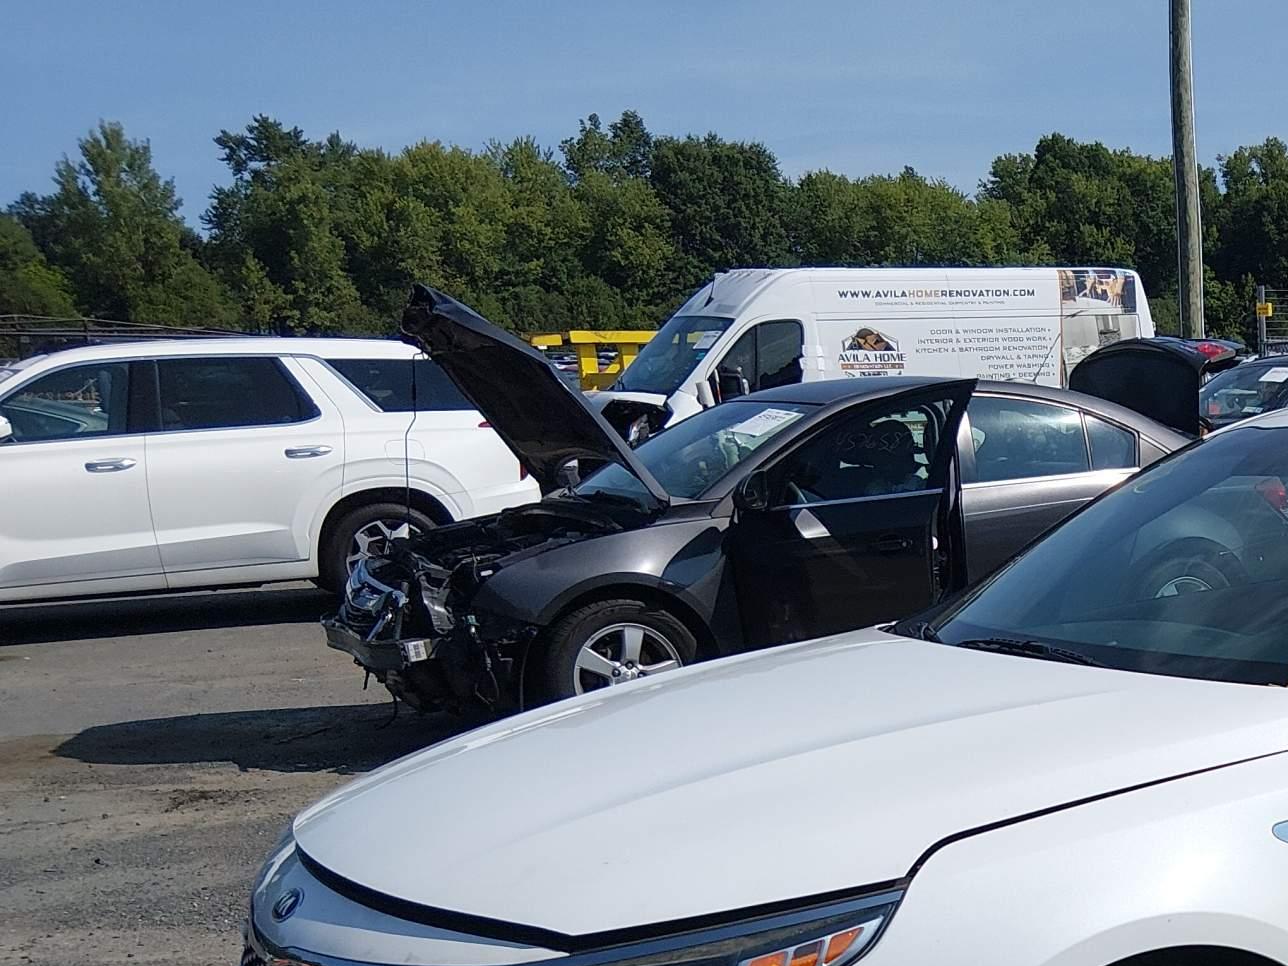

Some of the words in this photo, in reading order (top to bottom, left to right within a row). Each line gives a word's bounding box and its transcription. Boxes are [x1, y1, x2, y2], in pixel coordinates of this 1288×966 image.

[838, 288, 1035, 299] WWW.AVILAHOMERENOVATION.COM
[838, 353, 871, 363] AVILA
[874, 352, 907, 362] HOME
